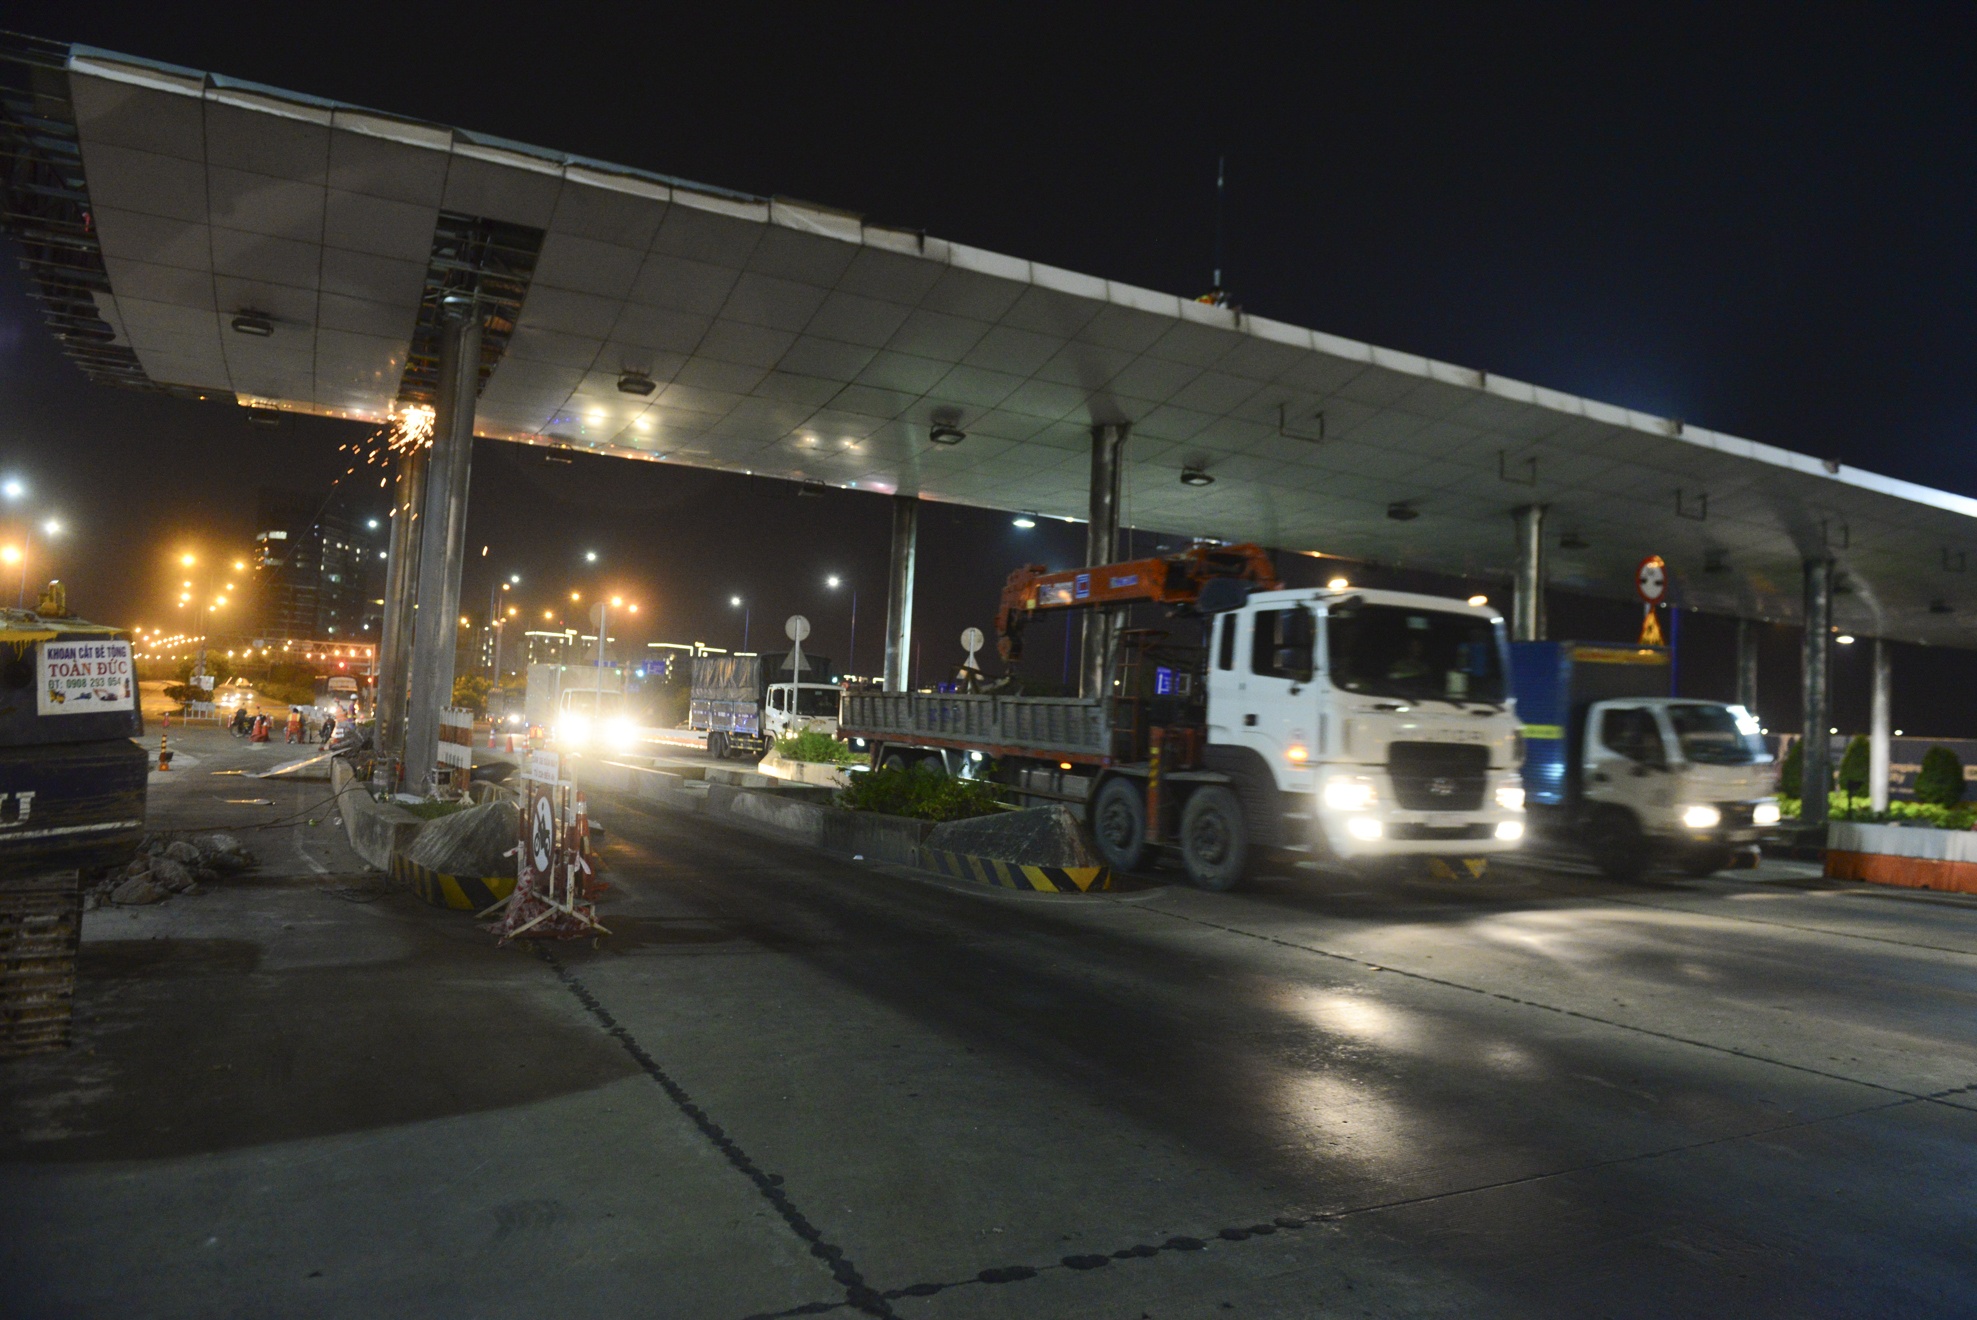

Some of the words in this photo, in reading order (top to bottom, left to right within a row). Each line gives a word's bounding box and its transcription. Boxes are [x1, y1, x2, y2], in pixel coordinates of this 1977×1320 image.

[47, 647, 76, 660] KHOAN
[107, 645, 126, 658] TÔNG
[97, 658, 127, 676] ĐỨC
[66, 678, 87, 688] 0908
